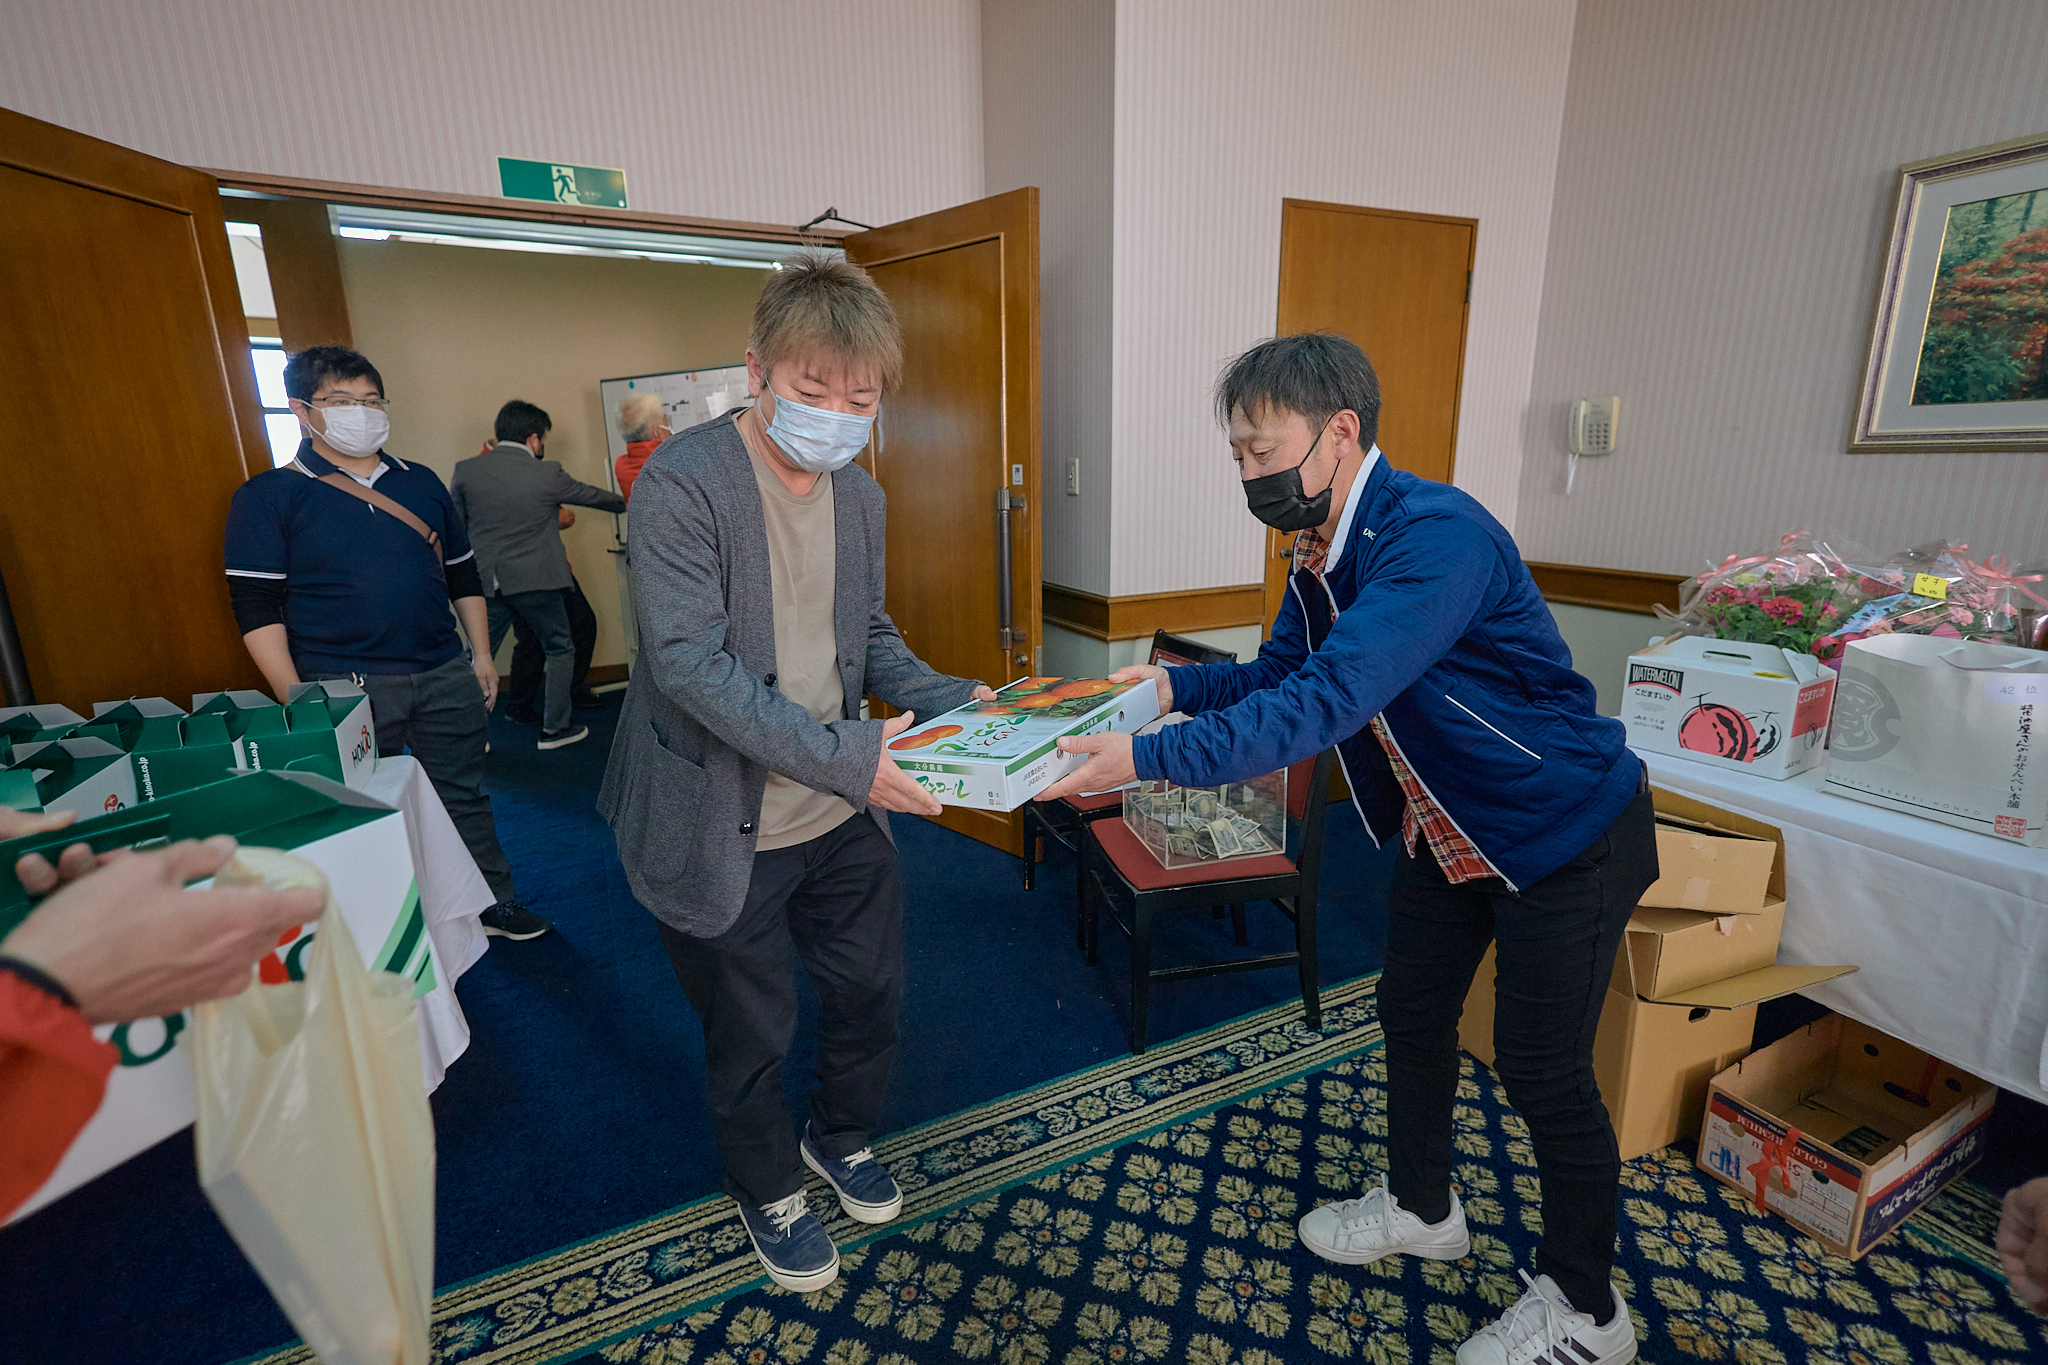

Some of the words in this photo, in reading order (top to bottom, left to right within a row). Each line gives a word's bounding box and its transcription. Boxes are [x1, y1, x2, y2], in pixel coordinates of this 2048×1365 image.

[1632, 665, 1681, 690] WATERMELON
[2000, 686, 2015, 694] 42
[2026, 685, 2038, 694] 位
[1635, 688, 1672, 701] こだますいか
[351, 724, 372, 769] HOKTO
[914, 762, 944, 772] 大分県産
[915, 775, 972, 799] アンコール
[1825, 773, 1871, 789] HOYUYA
[1880, 787, 1923, 803] SENBEI
[1933, 801, 1981, 816] HONPO
[1737, 1115, 1783, 1146] REMIUM
[1792, 1146, 1828, 1170] GOLD
